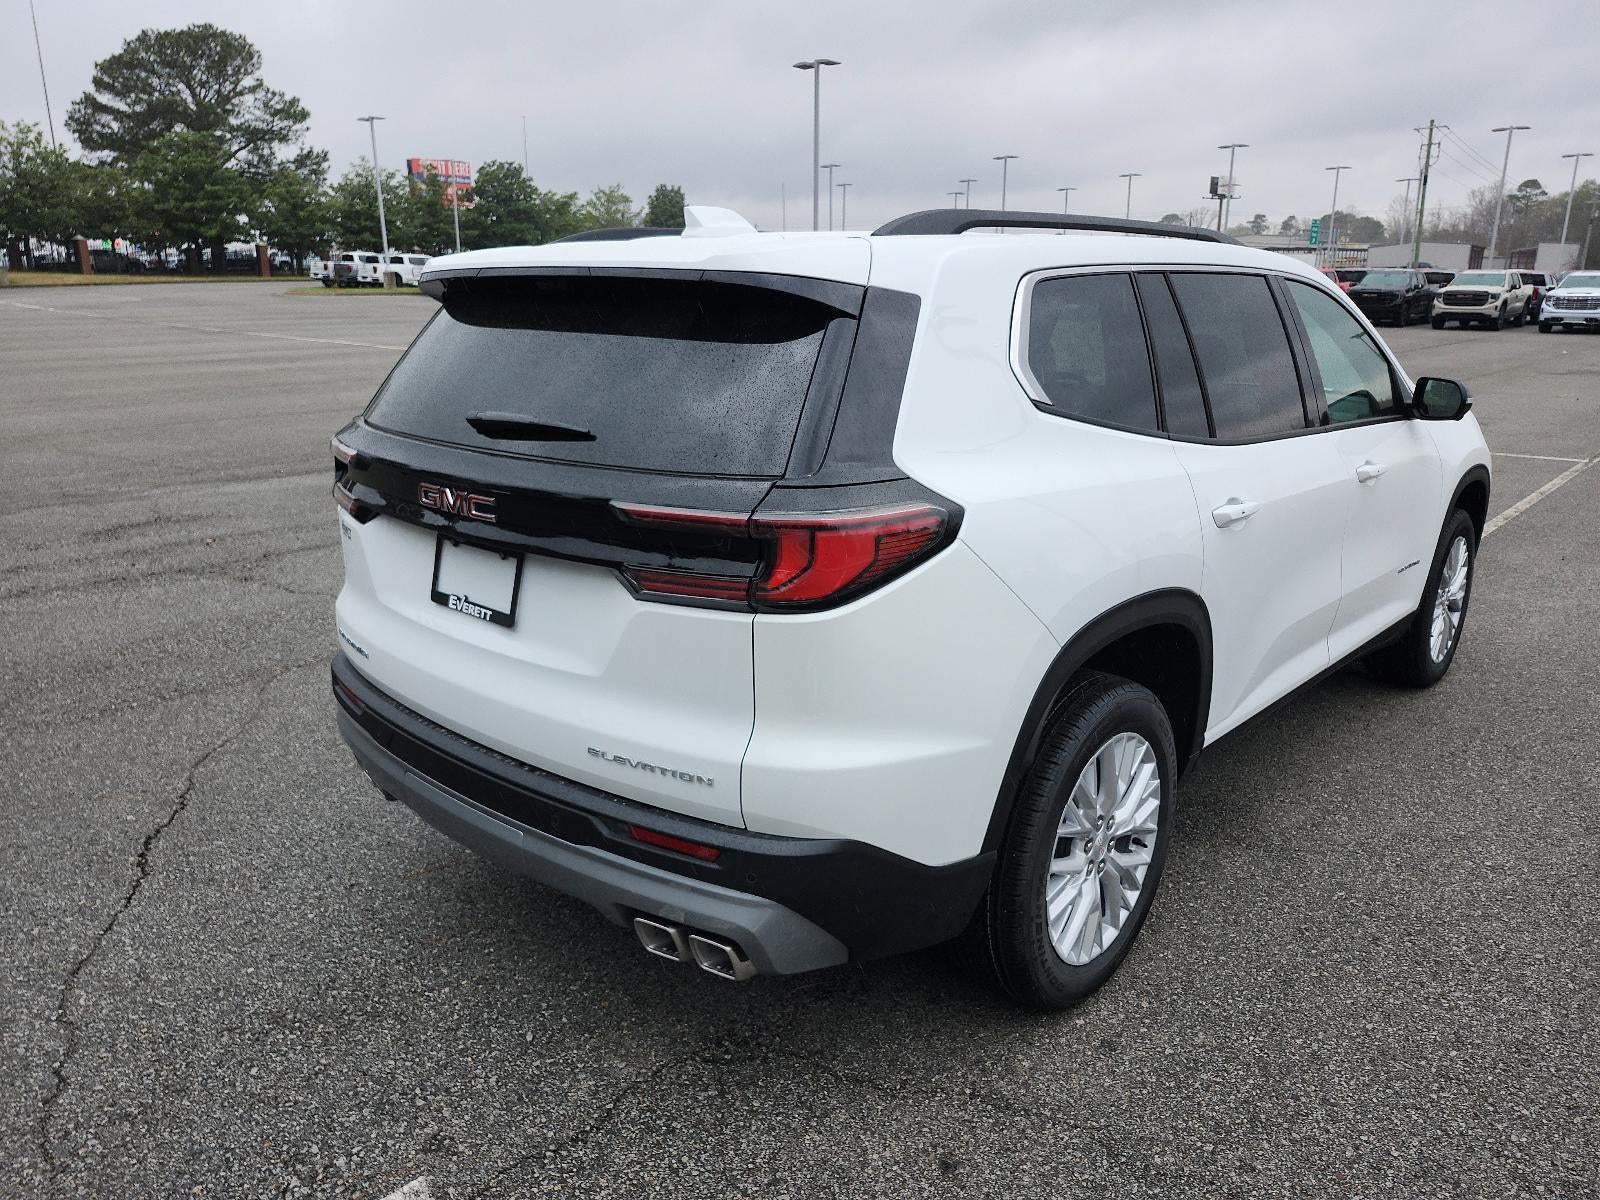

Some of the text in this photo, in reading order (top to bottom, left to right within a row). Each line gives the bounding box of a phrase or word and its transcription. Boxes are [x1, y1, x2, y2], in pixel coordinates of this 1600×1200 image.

[418, 482, 497, 523] GMC
[448, 594, 492, 621] EVERETT
[587, 746, 714, 787] ELEVATION
